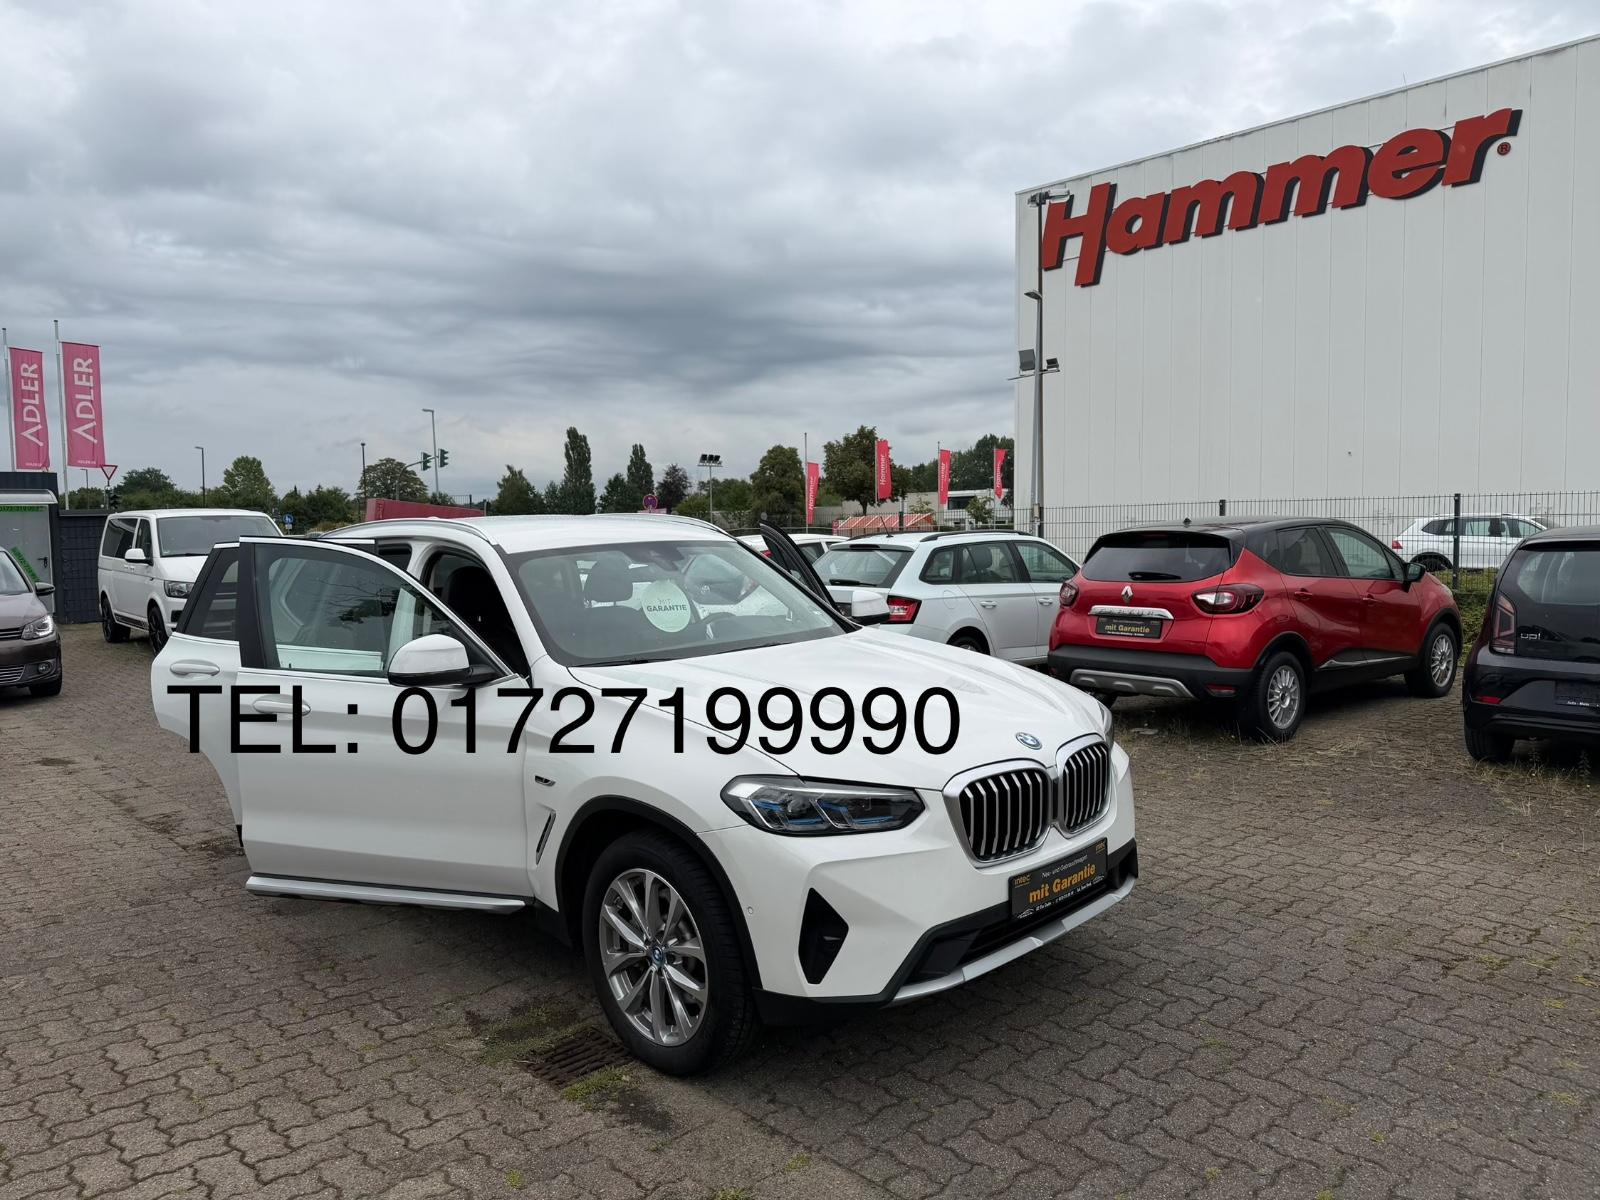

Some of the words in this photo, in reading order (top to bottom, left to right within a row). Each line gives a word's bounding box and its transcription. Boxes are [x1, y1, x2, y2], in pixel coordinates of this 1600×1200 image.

[1042, 108, 1523, 288] Hammer
[20, 362, 43, 447] ADLER
[73, 358, 98, 444] ADLER
[647, 604, 687, 612] GARANTIE
[1118, 624, 1150, 633] Garantie
[1029, 883, 1049, 903] mit
[1052, 863, 1096, 893] Garantie
